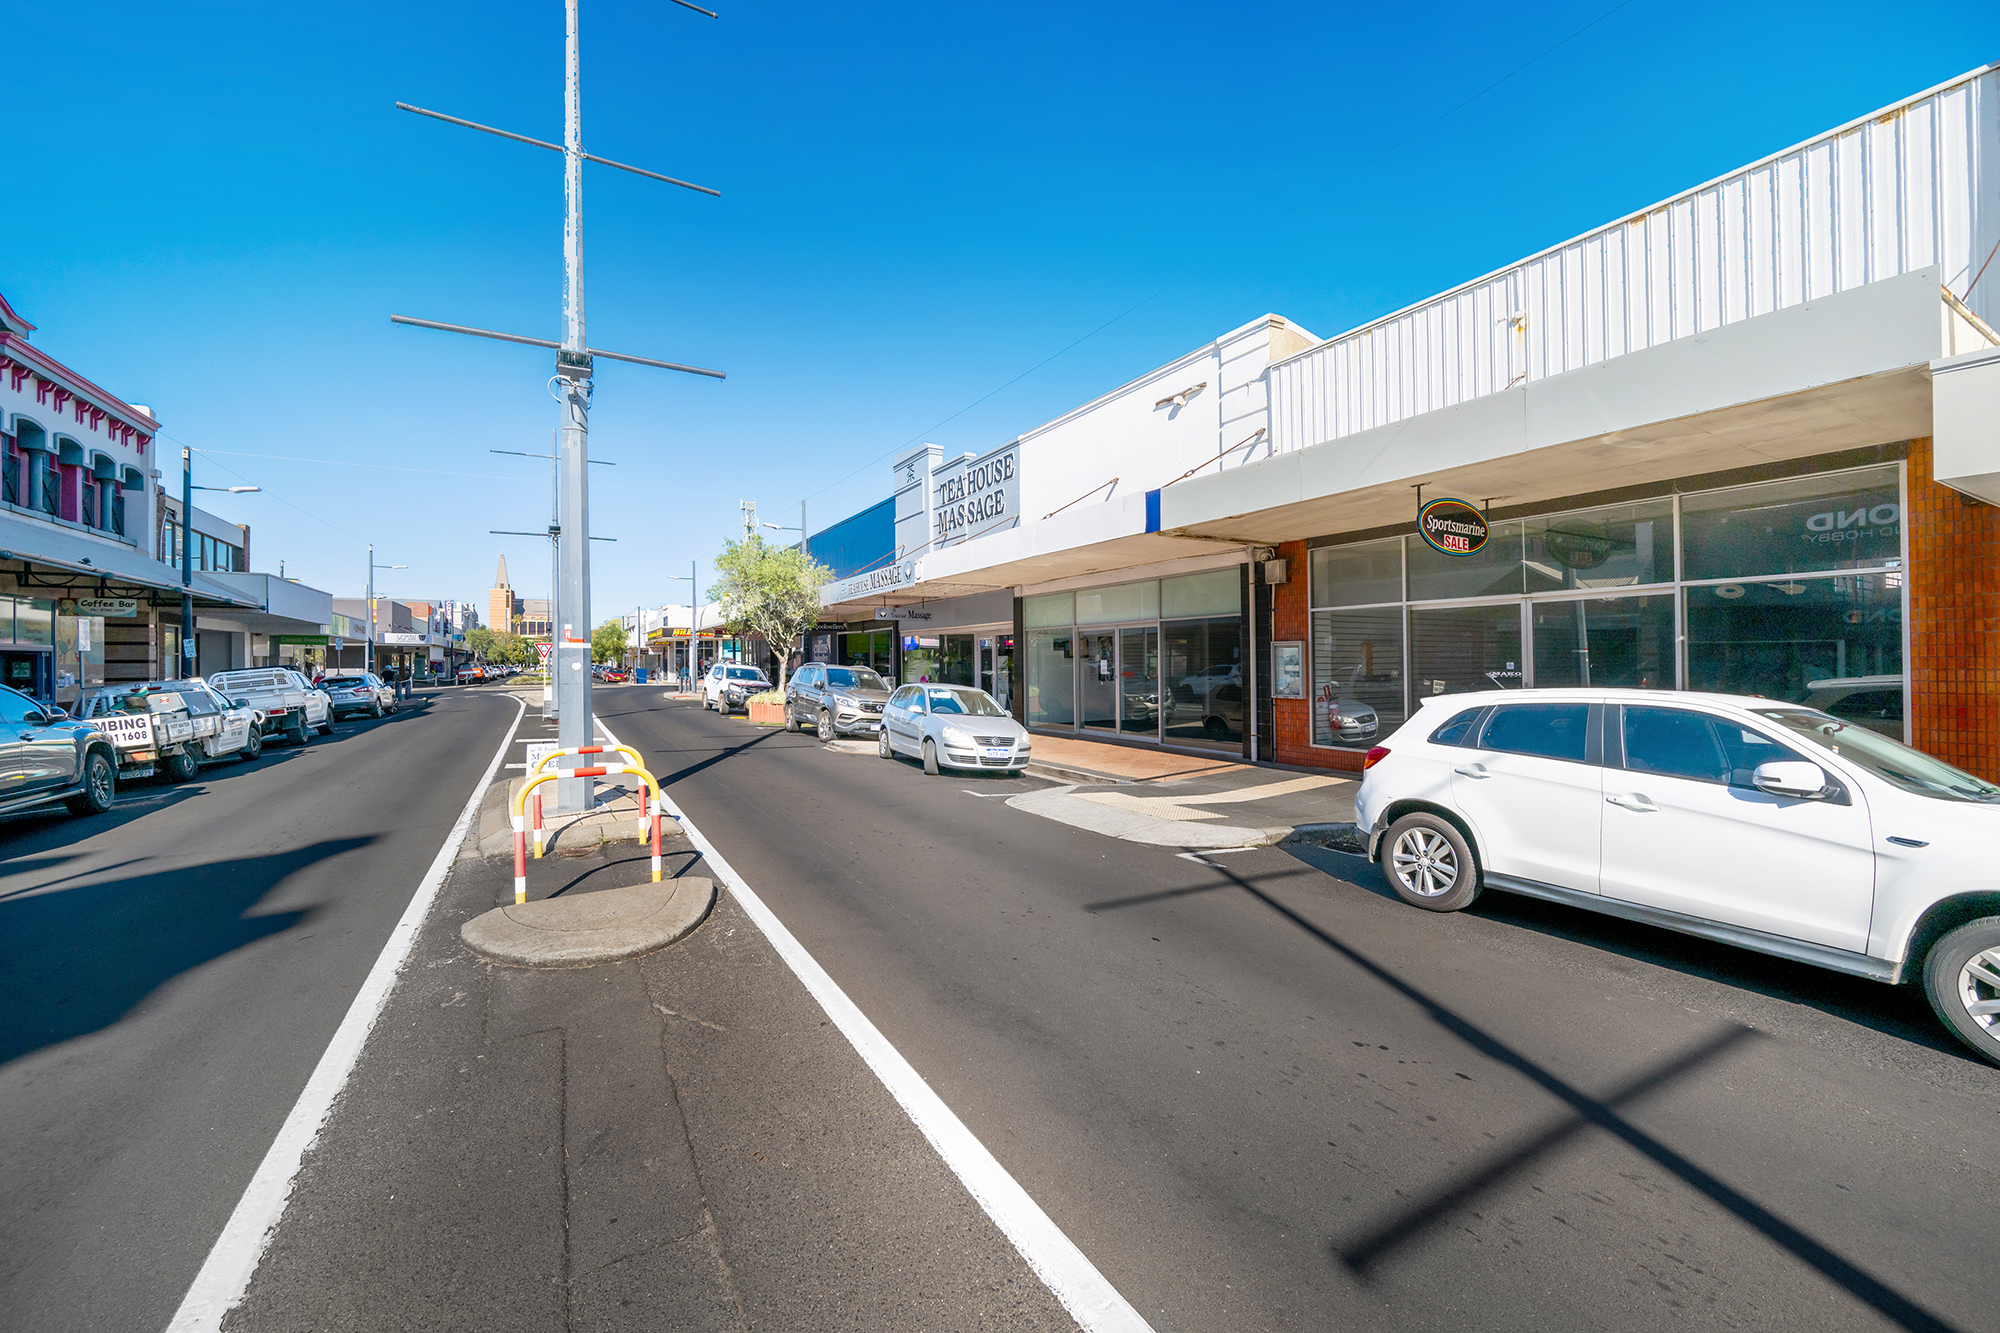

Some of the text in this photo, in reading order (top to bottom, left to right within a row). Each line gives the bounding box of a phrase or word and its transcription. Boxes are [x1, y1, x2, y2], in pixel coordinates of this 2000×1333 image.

[938, 489, 1005, 534] MASSAGE
[1426, 514, 1486, 537] Sportsmarine
[1444, 535, 1468, 551] SALE
[869, 566, 902, 590] MASSAGE
[80, 600, 136, 608] Coffee Bar
[908, 609, 932, 620] Massage
[122, 731, 148, 742] 1608
